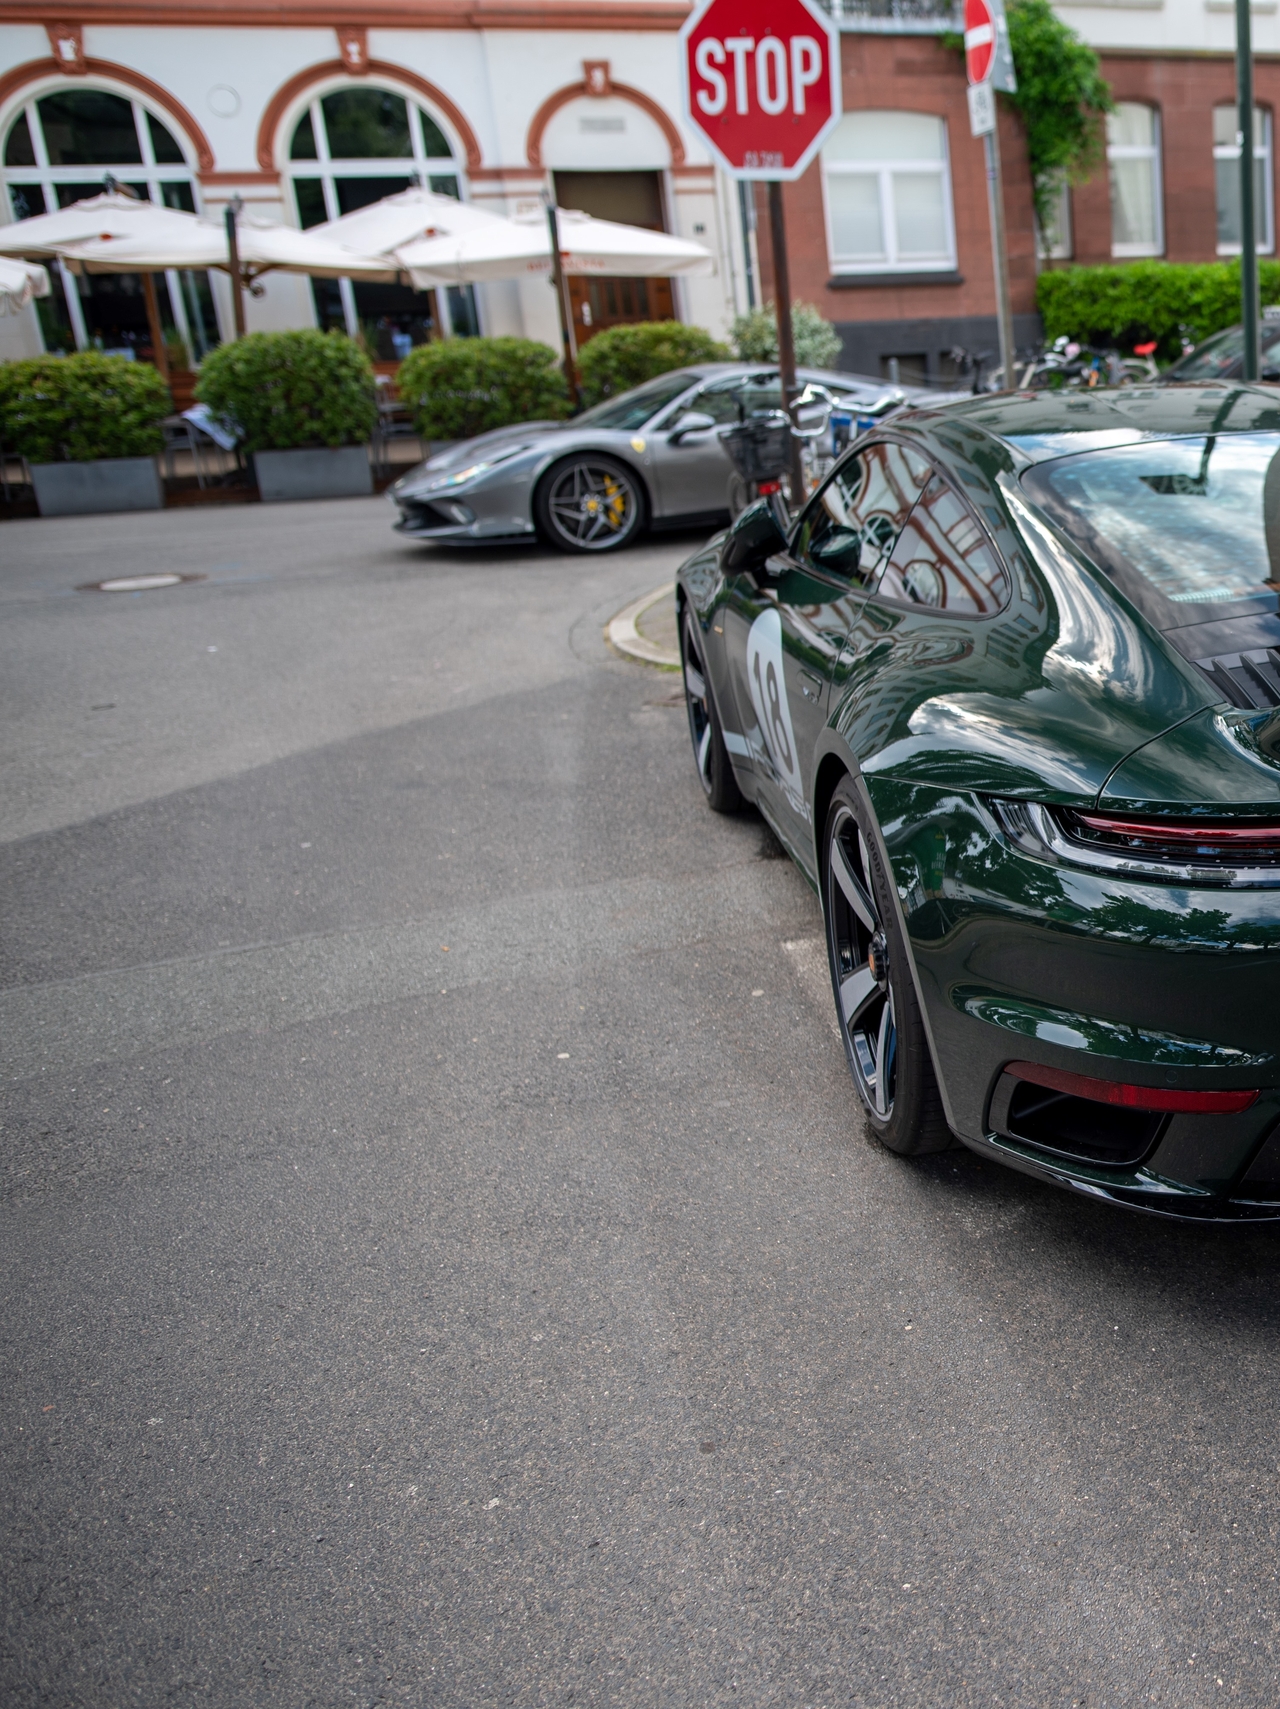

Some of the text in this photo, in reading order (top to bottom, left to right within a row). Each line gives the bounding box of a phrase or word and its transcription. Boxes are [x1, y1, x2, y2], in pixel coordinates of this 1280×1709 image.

[695, 35, 822, 116] STOP
[753, 651, 794, 775] 18
[866, 832, 893, 930] GOODYEAR
